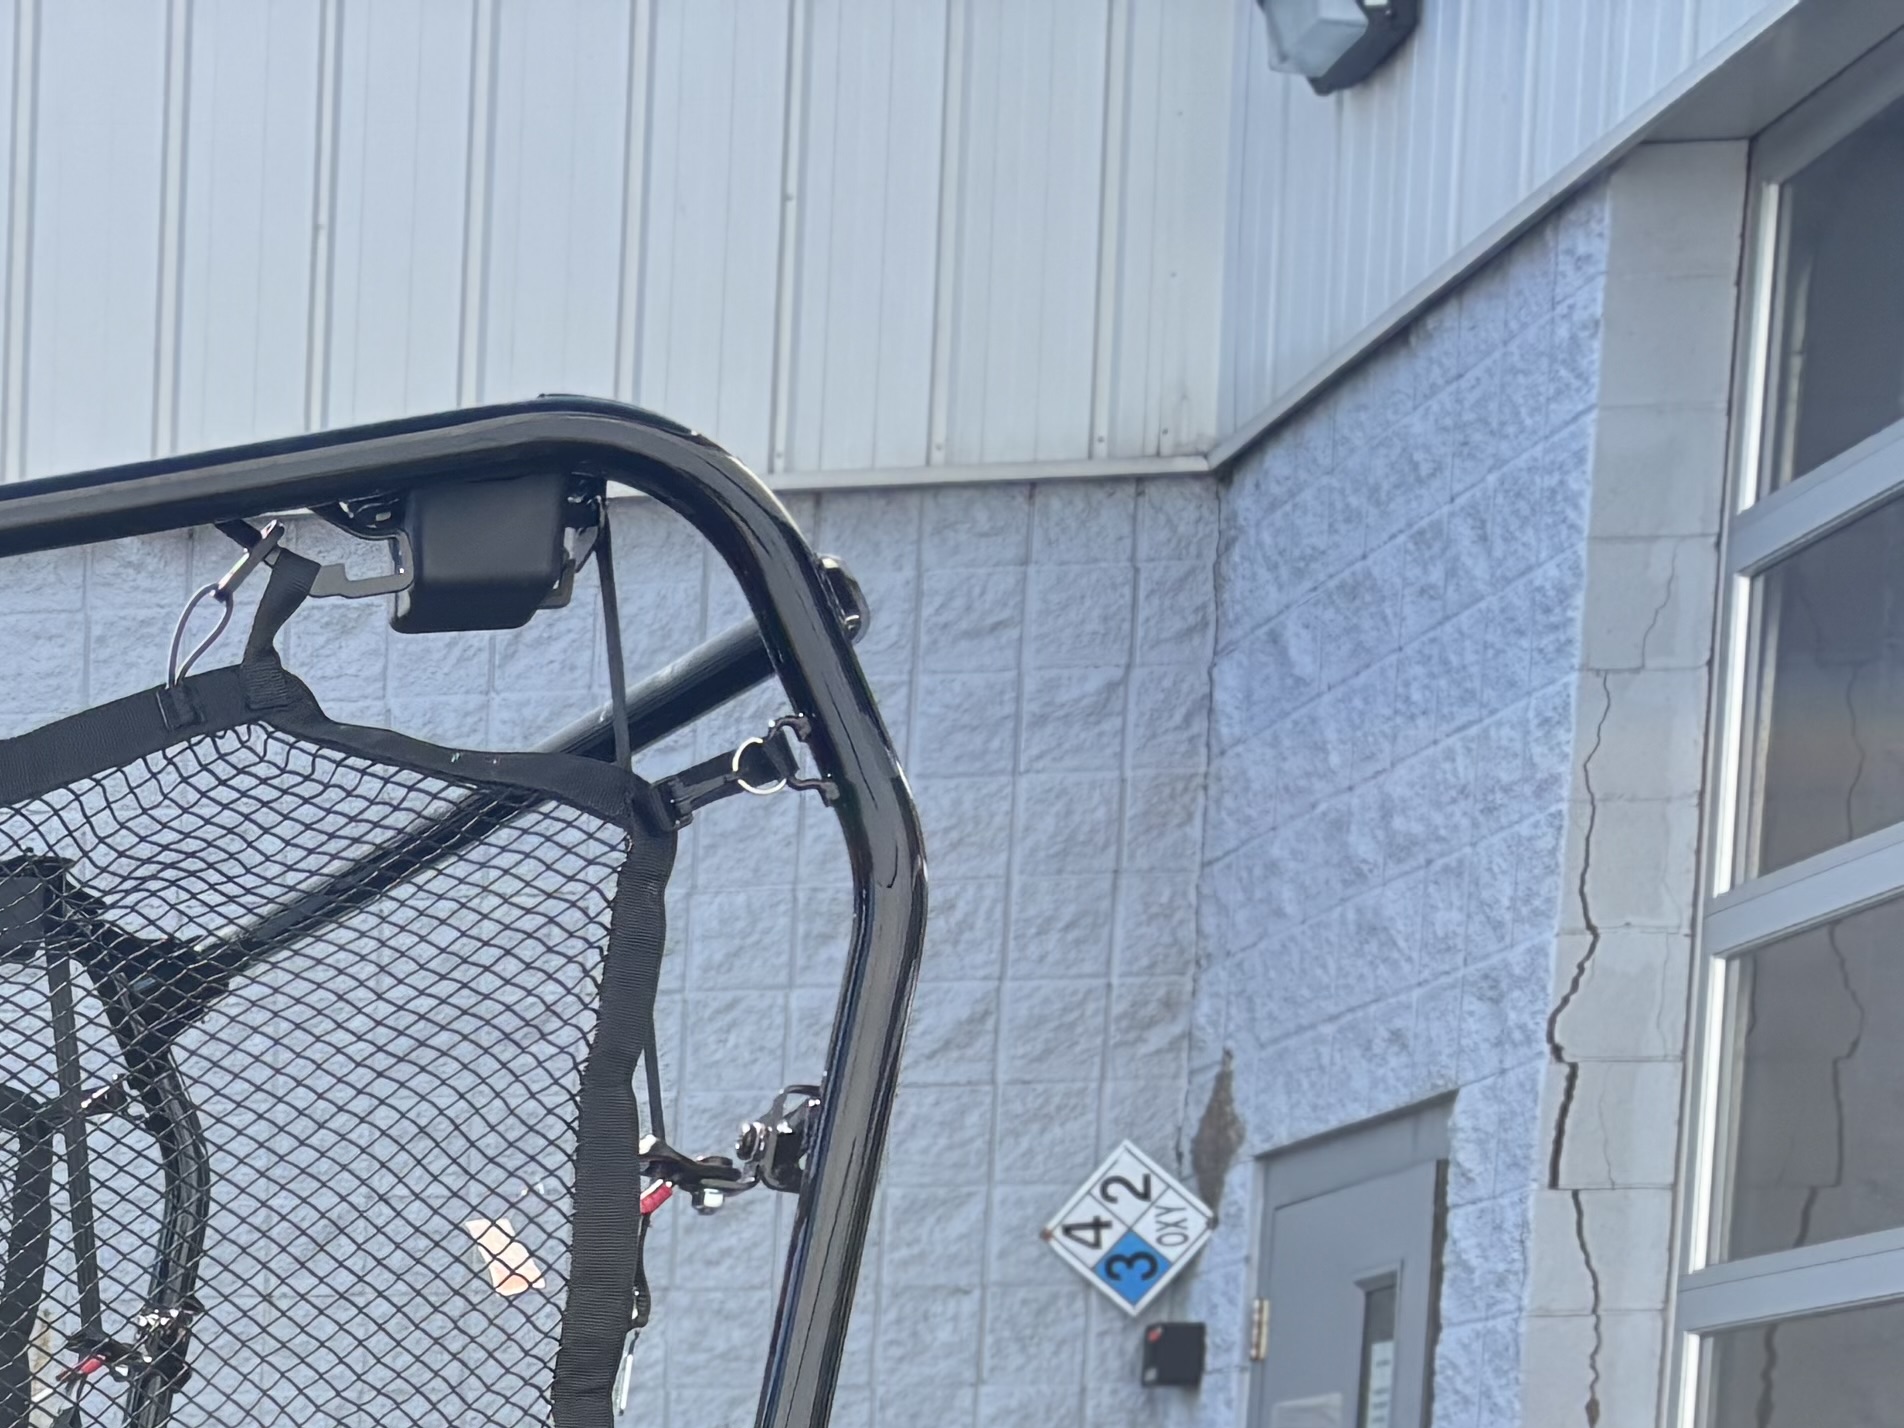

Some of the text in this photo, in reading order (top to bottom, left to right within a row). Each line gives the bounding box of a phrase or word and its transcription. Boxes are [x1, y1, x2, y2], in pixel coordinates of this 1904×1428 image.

[1100, 1174, 1152, 1204] 2
[1062, 1215, 1113, 1250] 4
[1154, 1205, 1190, 1247] OXY
[1105, 1251, 1159, 1281] 3
